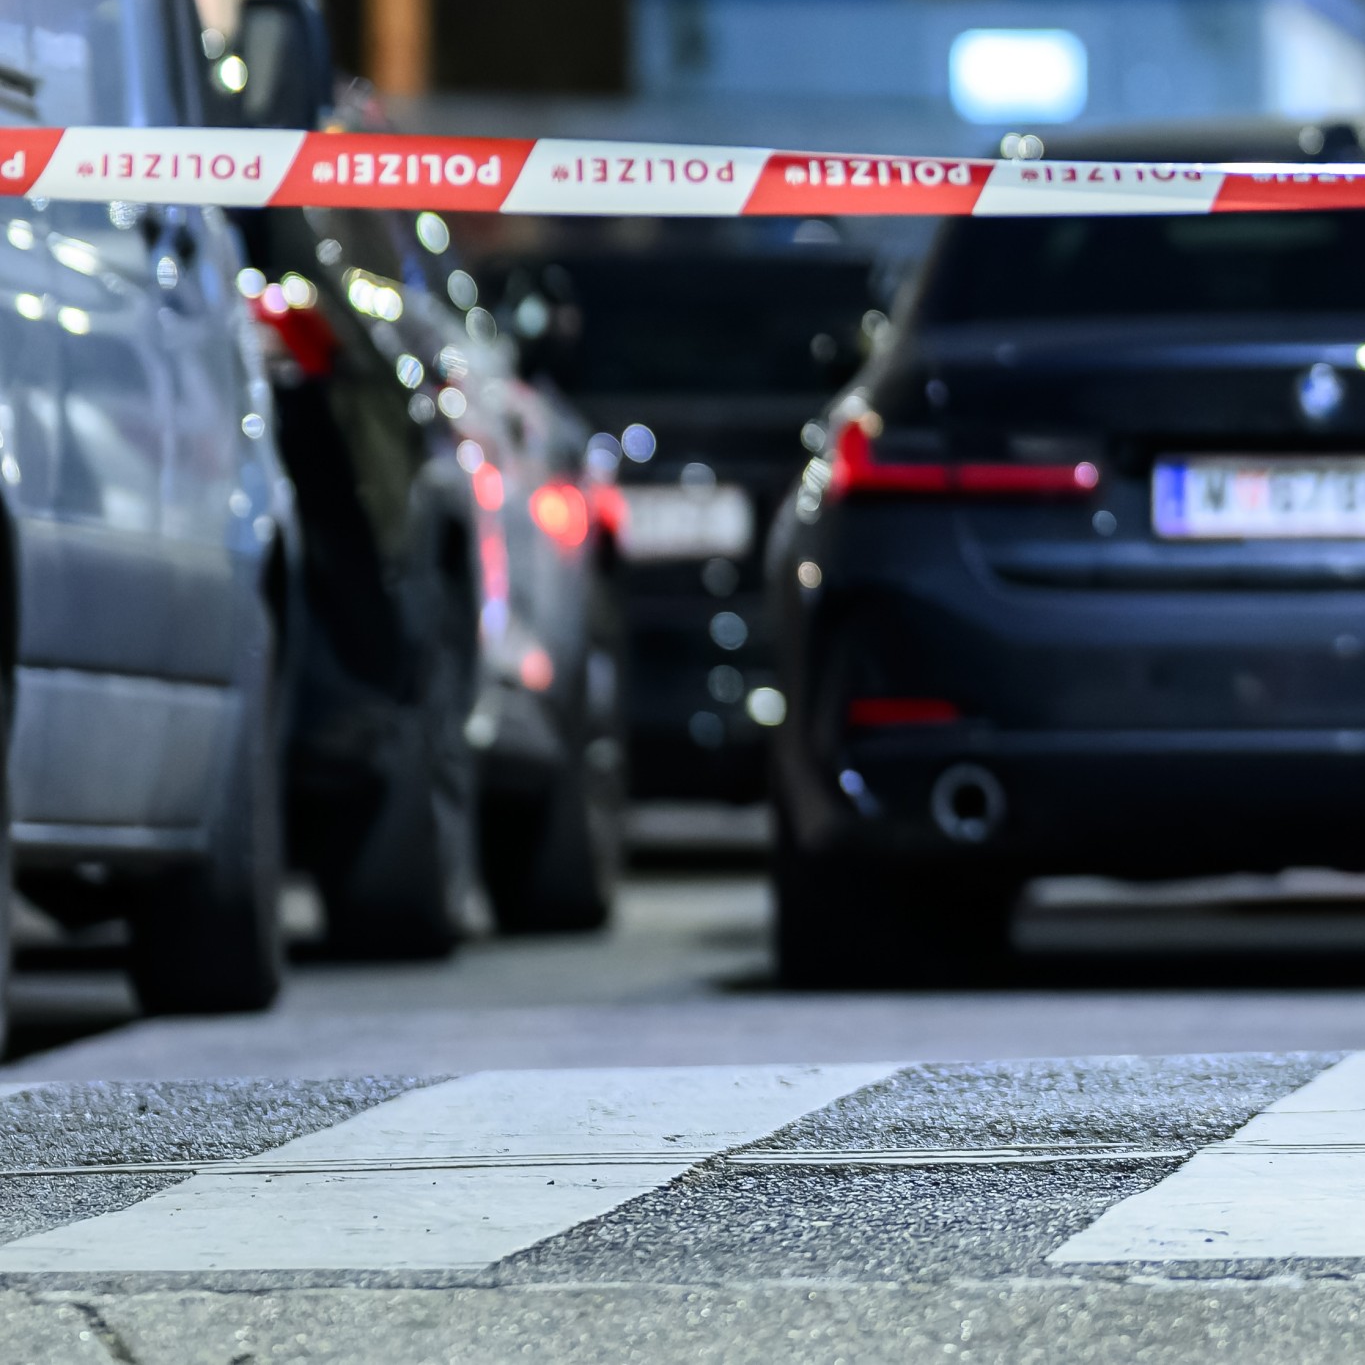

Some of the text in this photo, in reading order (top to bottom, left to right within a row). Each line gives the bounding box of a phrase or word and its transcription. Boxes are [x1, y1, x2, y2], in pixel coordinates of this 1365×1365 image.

[102, 153, 261, 180] POLIZEI
[336, 152, 501, 186] POLIZEI
[575, 157, 735, 183] POLIZEI
[808, 159, 971, 186] POLIZEI
